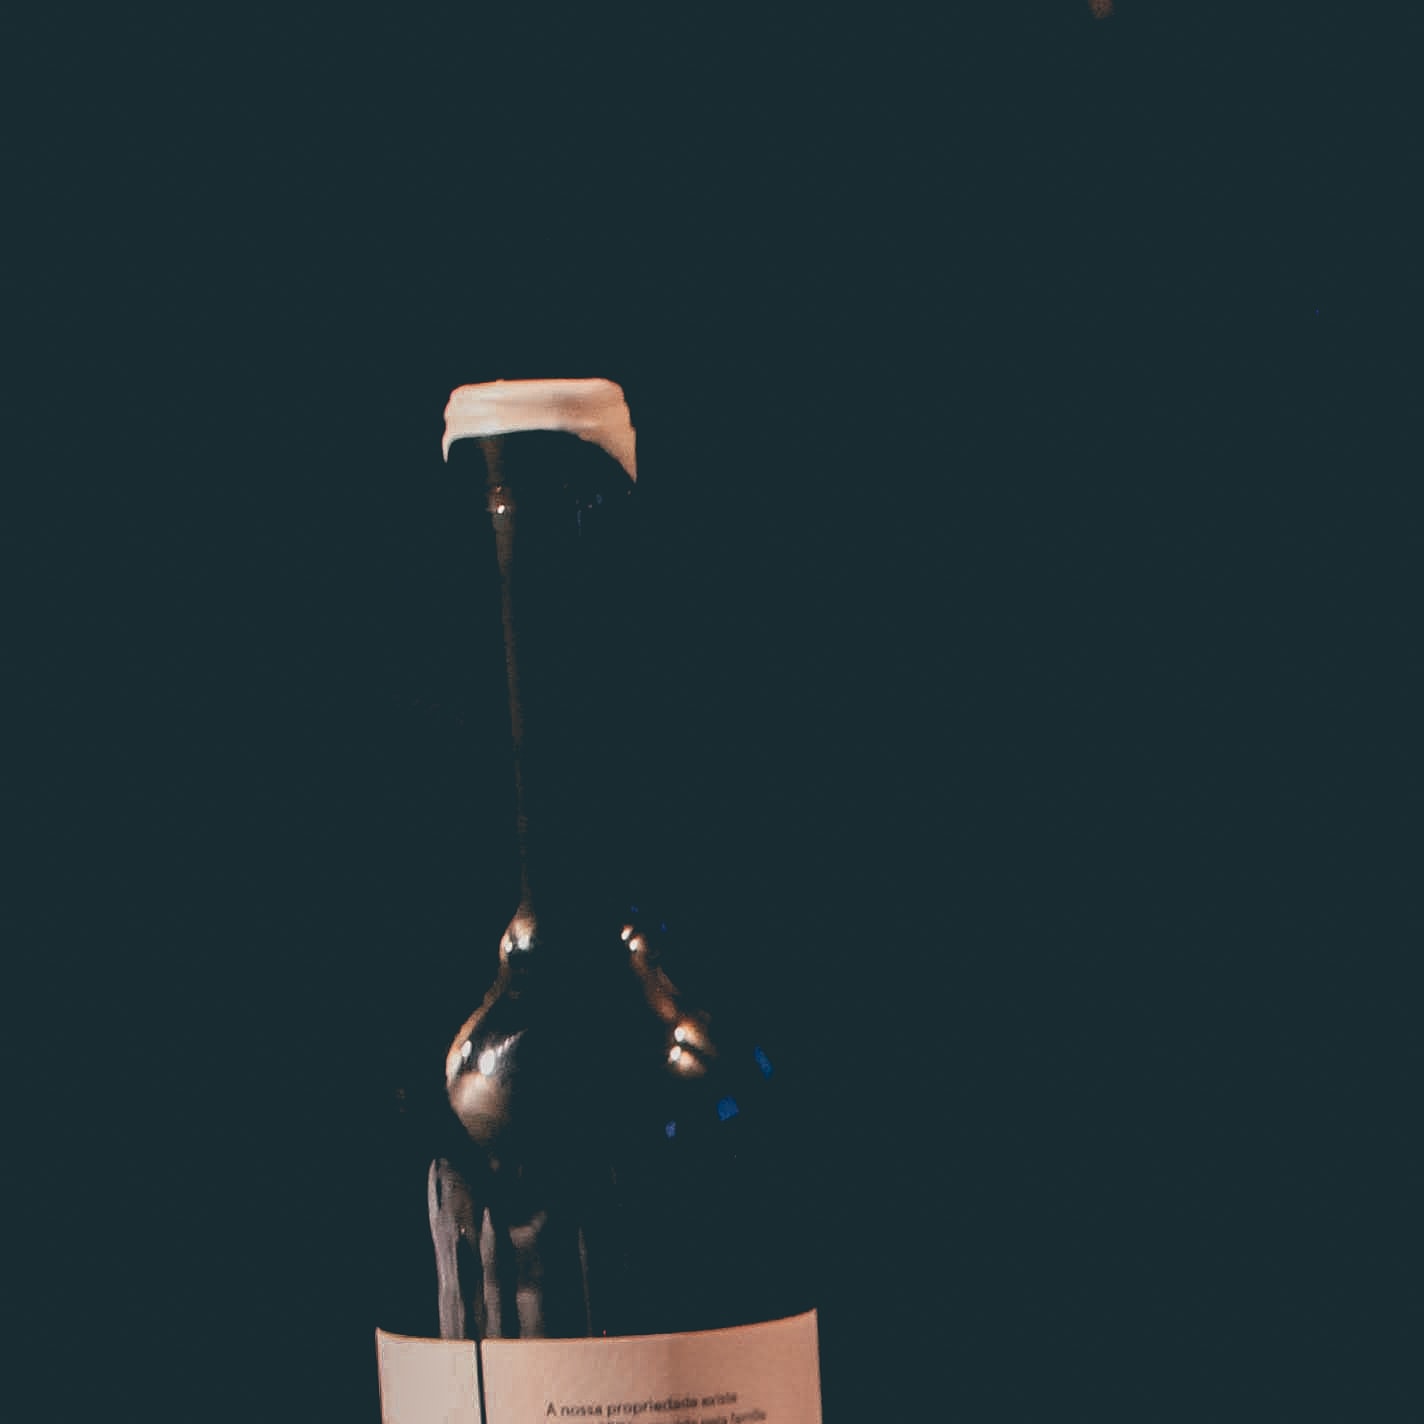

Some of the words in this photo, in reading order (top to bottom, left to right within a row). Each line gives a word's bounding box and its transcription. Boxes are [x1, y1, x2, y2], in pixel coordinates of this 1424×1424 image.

[545, 1400, 557, 1416] A
[560, 1404, 603, 1417] nossa
[606, 1395, 698, 1418] propriedade
